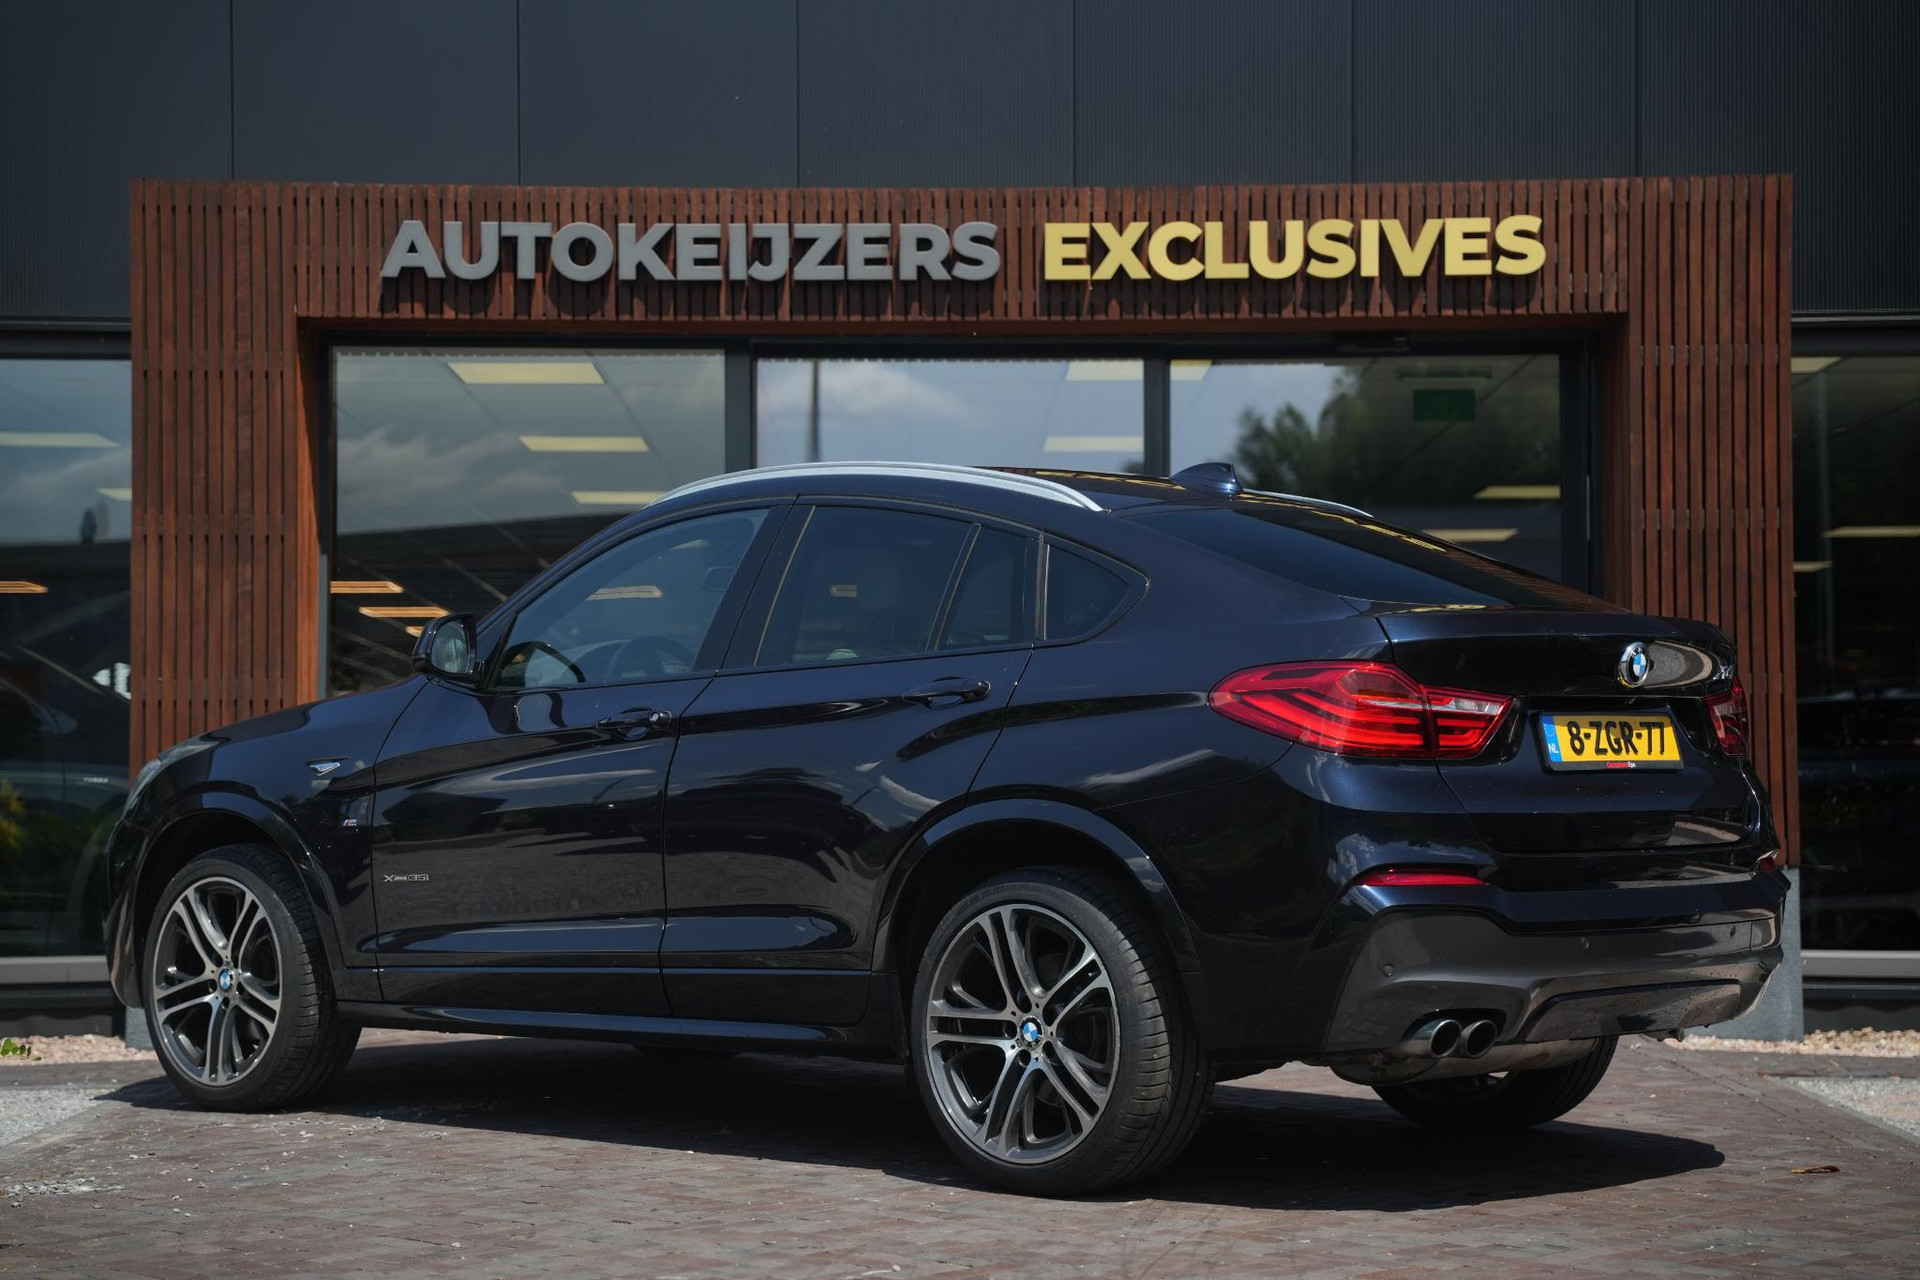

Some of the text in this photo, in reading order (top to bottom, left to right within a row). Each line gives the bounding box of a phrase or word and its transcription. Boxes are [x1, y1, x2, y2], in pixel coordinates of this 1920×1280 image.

[380, 214, 1547, 282] AUTOKEIJZERS EXCLUSIVES
[1548, 720, 1665, 755] NL 8-ZGR-77
